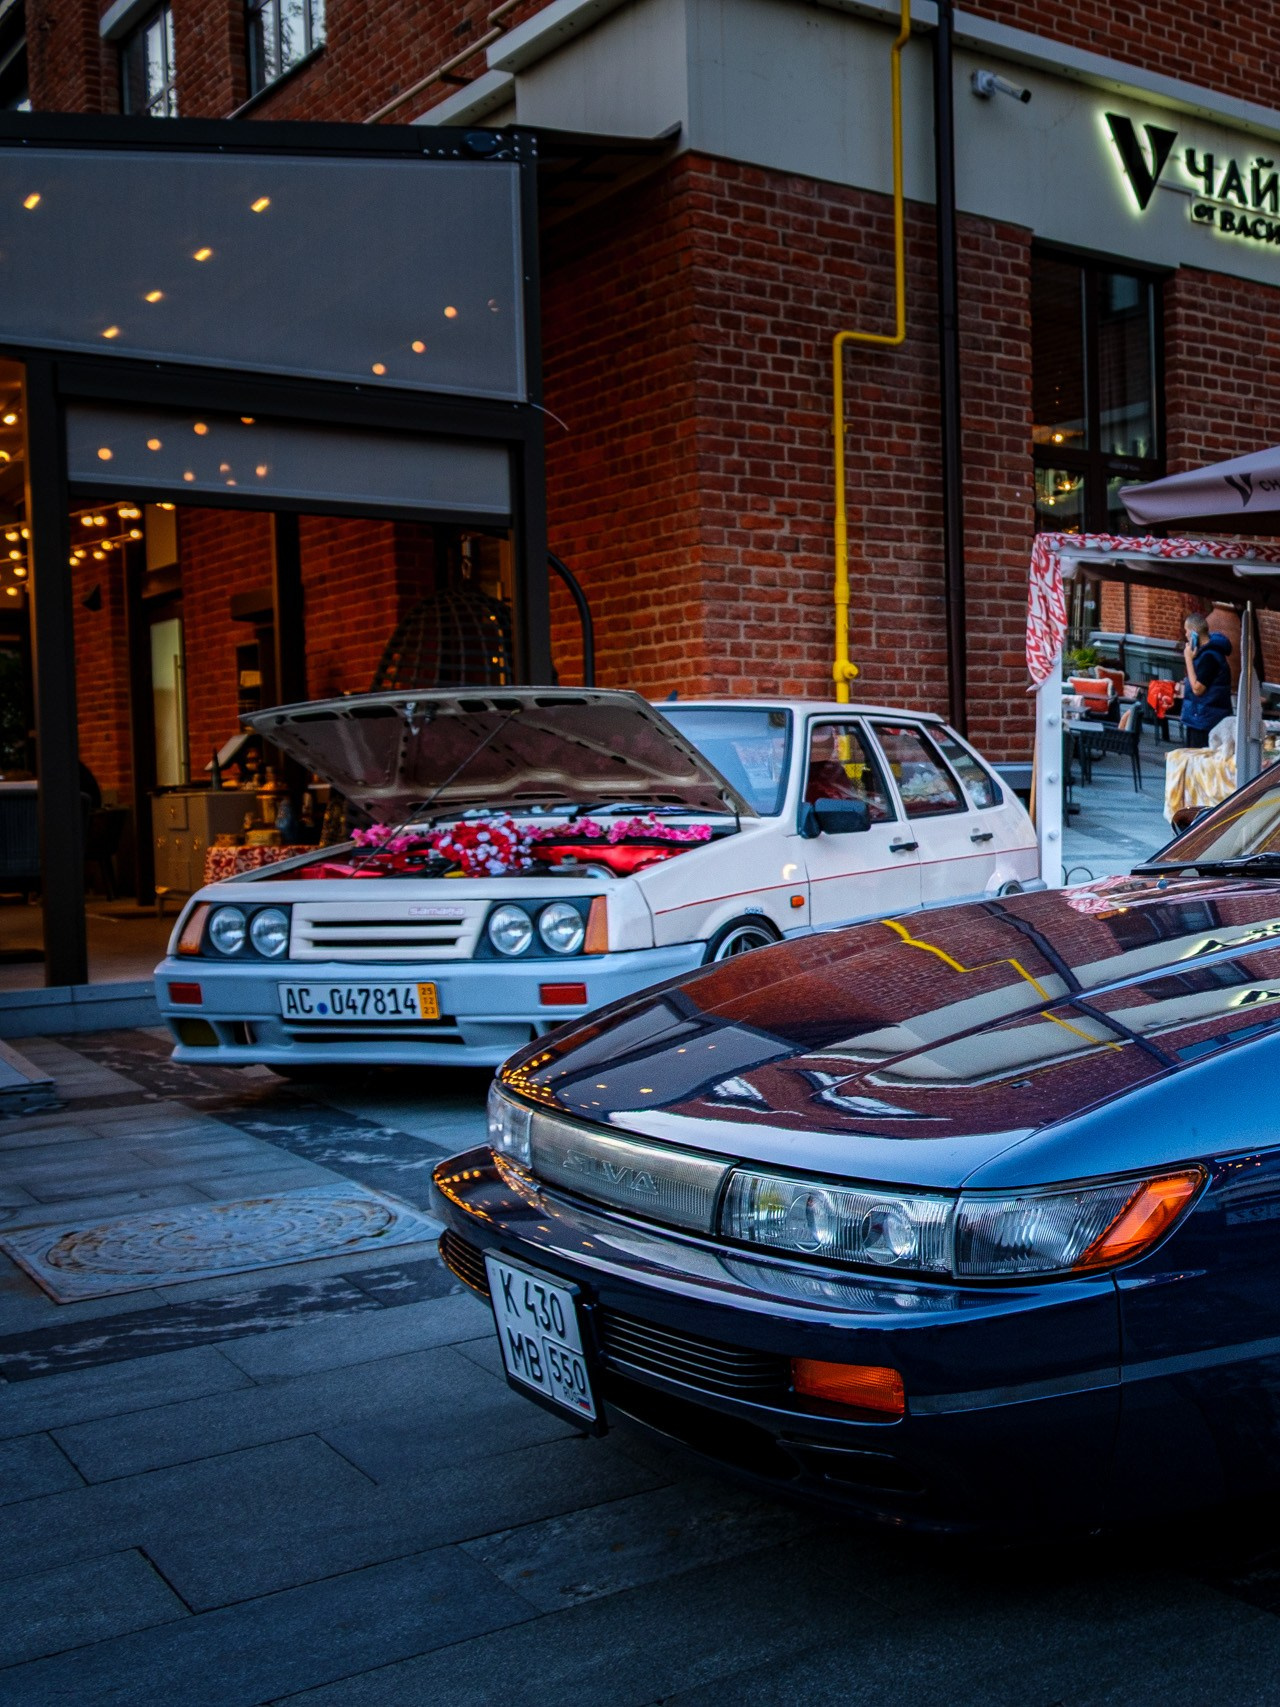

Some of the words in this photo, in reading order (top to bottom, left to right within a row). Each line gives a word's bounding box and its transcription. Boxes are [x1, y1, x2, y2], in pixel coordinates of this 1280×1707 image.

[286, 988, 313, 1014] AC
[330, 988, 416, 1014] 047814
[421, 987, 433, 995] 25
[500, 1268, 520, 1317] K
[525, 1280, 566, 1339] 430
[507, 1327, 543, 1384] MB
[548, 1343, 586, 1395] 550
